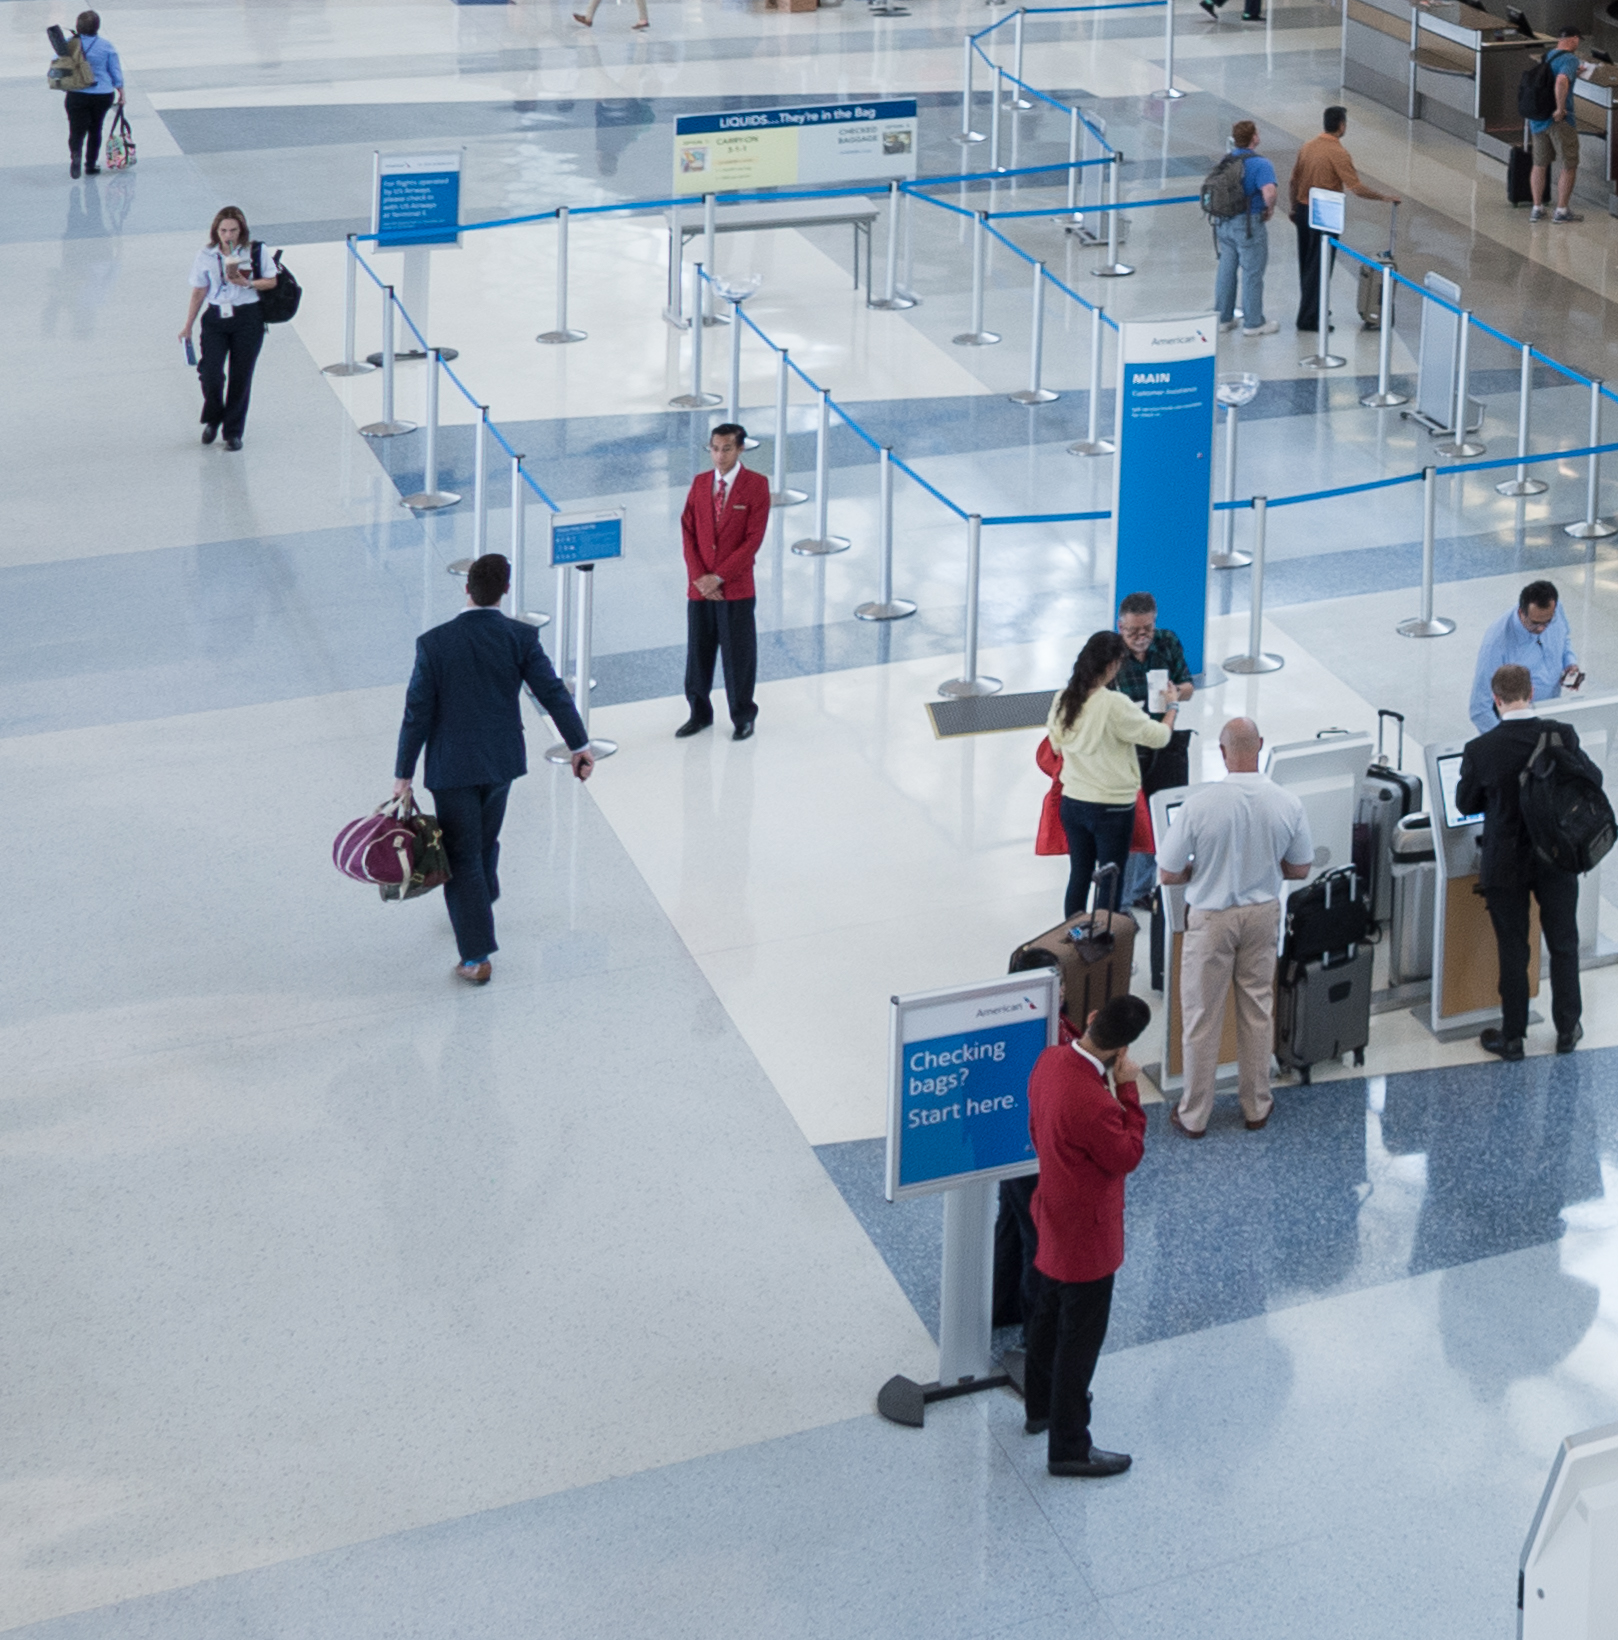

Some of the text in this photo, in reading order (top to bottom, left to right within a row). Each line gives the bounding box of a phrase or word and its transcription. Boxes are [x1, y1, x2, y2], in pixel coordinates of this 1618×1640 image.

[821, 110, 832, 120] in
[833, 108, 852, 119] the
[855, 107, 877, 119] Bag
[838, 125, 878, 135] CHECKED
[838, 134, 878, 145] BAGGAGE
[1151, 336, 1196, 346] American
[1132, 372, 1171, 384] MAIN
[975, 1002, 1023, 1018] American
[909, 1040, 1006, 1072] Checking
[909, 1067, 970, 1096] bags?
[908, 1094, 1019, 1129] Start here.
